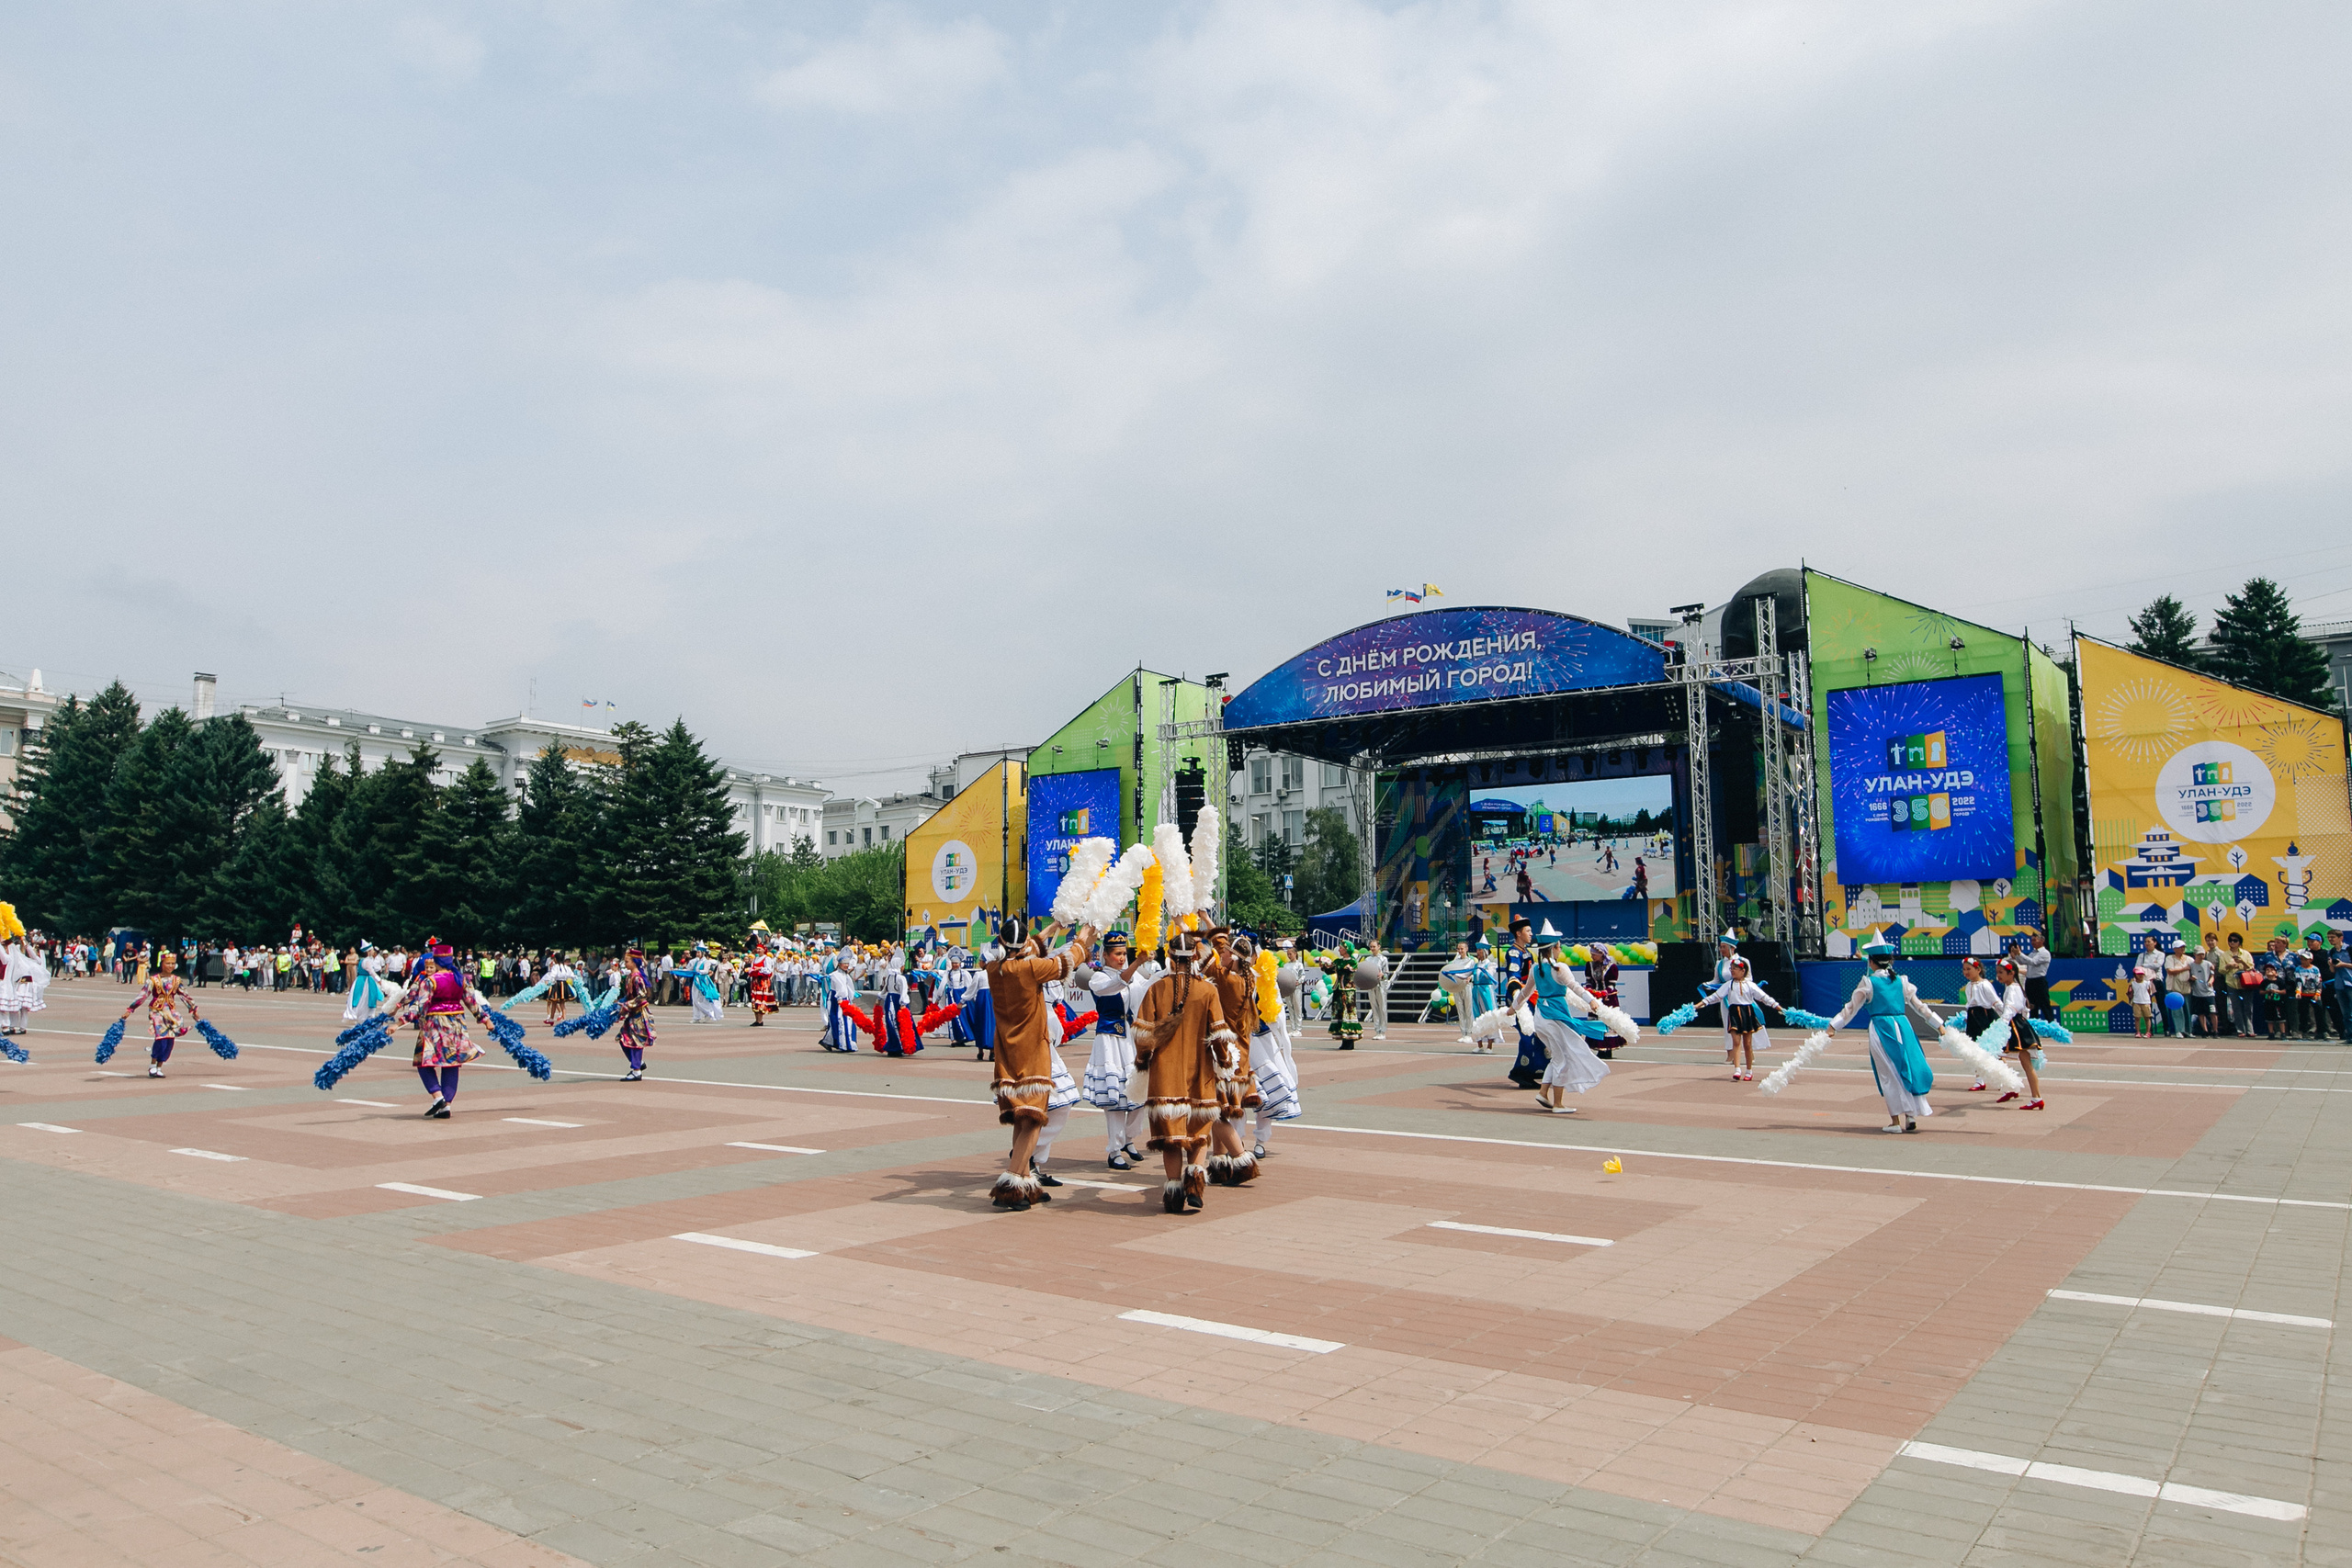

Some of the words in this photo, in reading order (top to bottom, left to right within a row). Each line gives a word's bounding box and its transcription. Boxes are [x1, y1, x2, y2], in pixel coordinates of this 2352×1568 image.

[1317, 660, 1332, 677] С
[1336, 649, 1397, 677] ДНЁМ
[1403, 631, 1542, 665] РОЖДЕНИЯ,
[1324, 669, 1441, 704] ЛЮБИМЫЙ
[1447, 661, 1532, 689] ГОРОД!
[1864, 770, 1974, 793] УЛАН-УДЭ
[2178, 786, 2251, 799] УЛАН-УДЭ
[1868, 802, 1888, 811] 1666
[1893, 797, 1949, 822] 356
[1951, 796, 1975, 806] 2022
